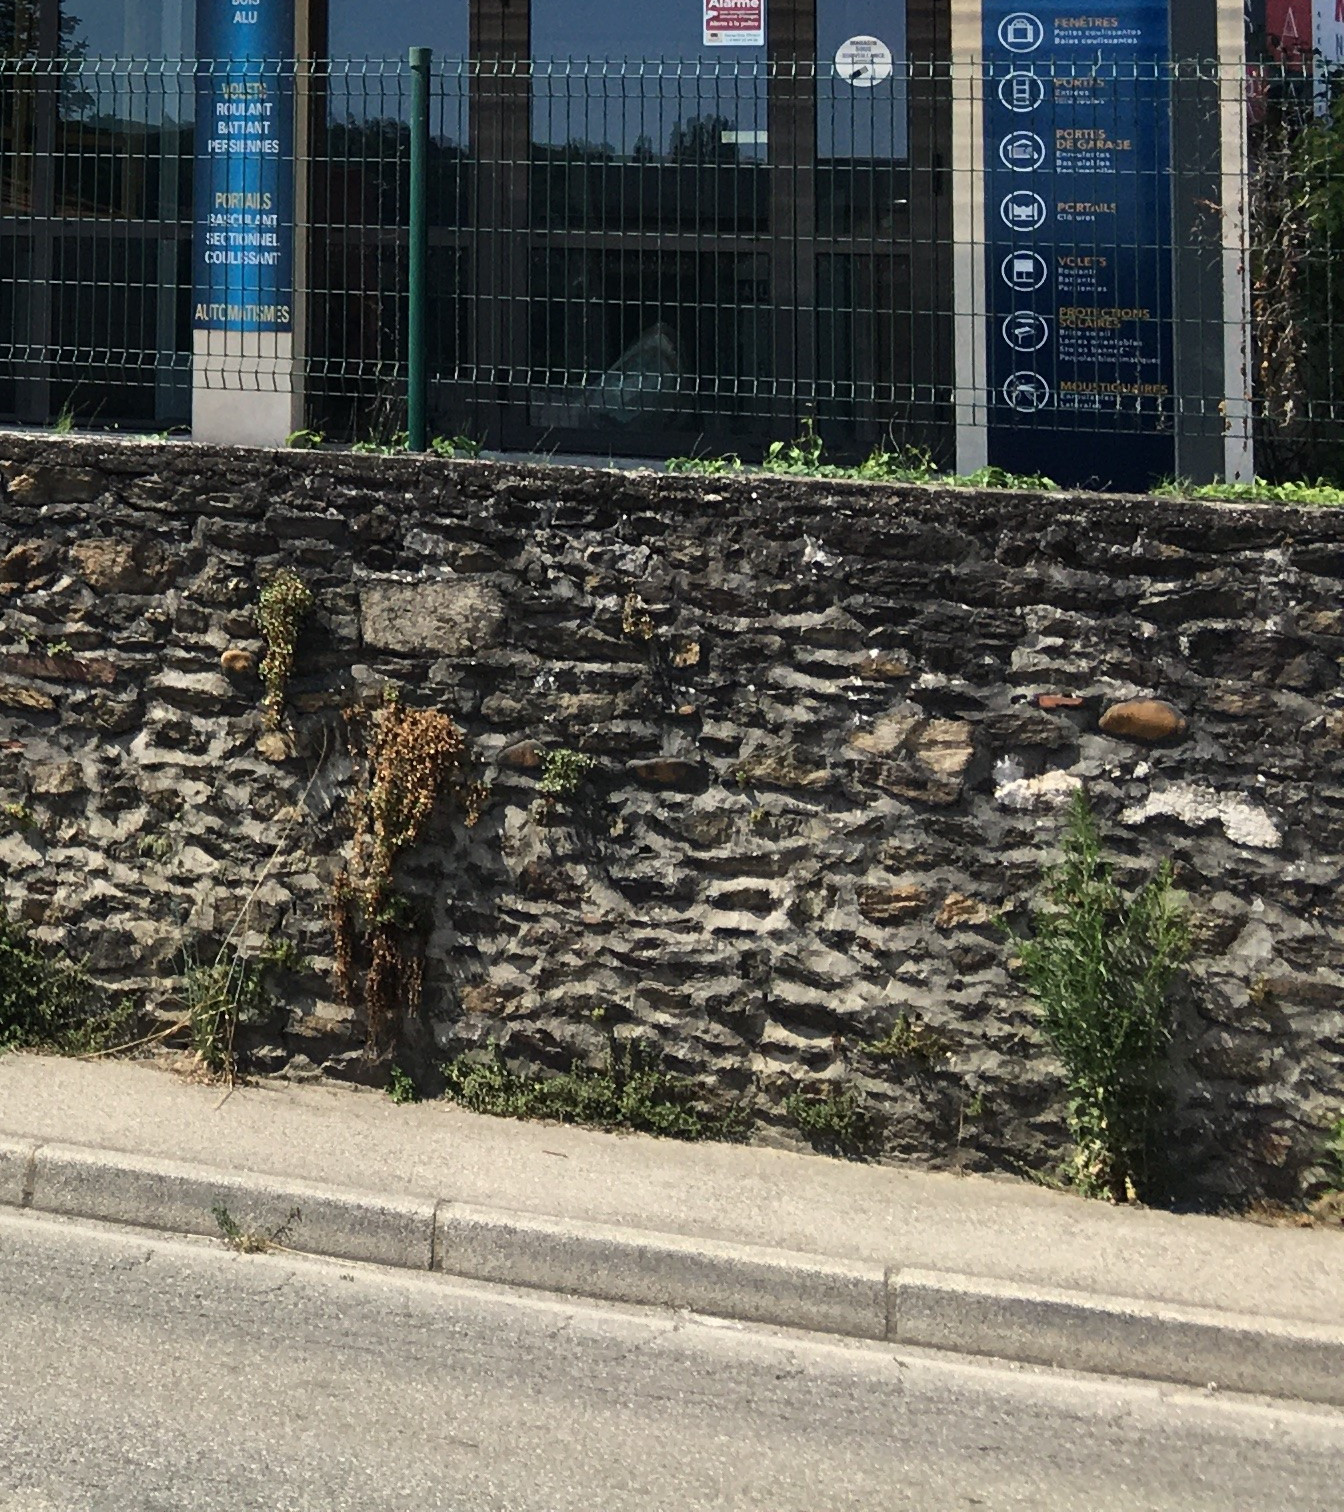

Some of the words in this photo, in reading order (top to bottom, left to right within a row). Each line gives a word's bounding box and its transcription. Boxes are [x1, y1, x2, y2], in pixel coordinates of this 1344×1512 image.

[233, 10, 257, 24] ALU
[1054, 17, 1118, 28] FENÊTRES
[216, 102, 273, 116] ROULANT
[217, 121, 271, 134] BATTANT
[1056, 130, 1106, 139] PORTES
[208, 139, 280, 153] PERSIENNES
[1056, 139, 1074, 149] DE
[215, 192, 272, 210] PORTAILS
